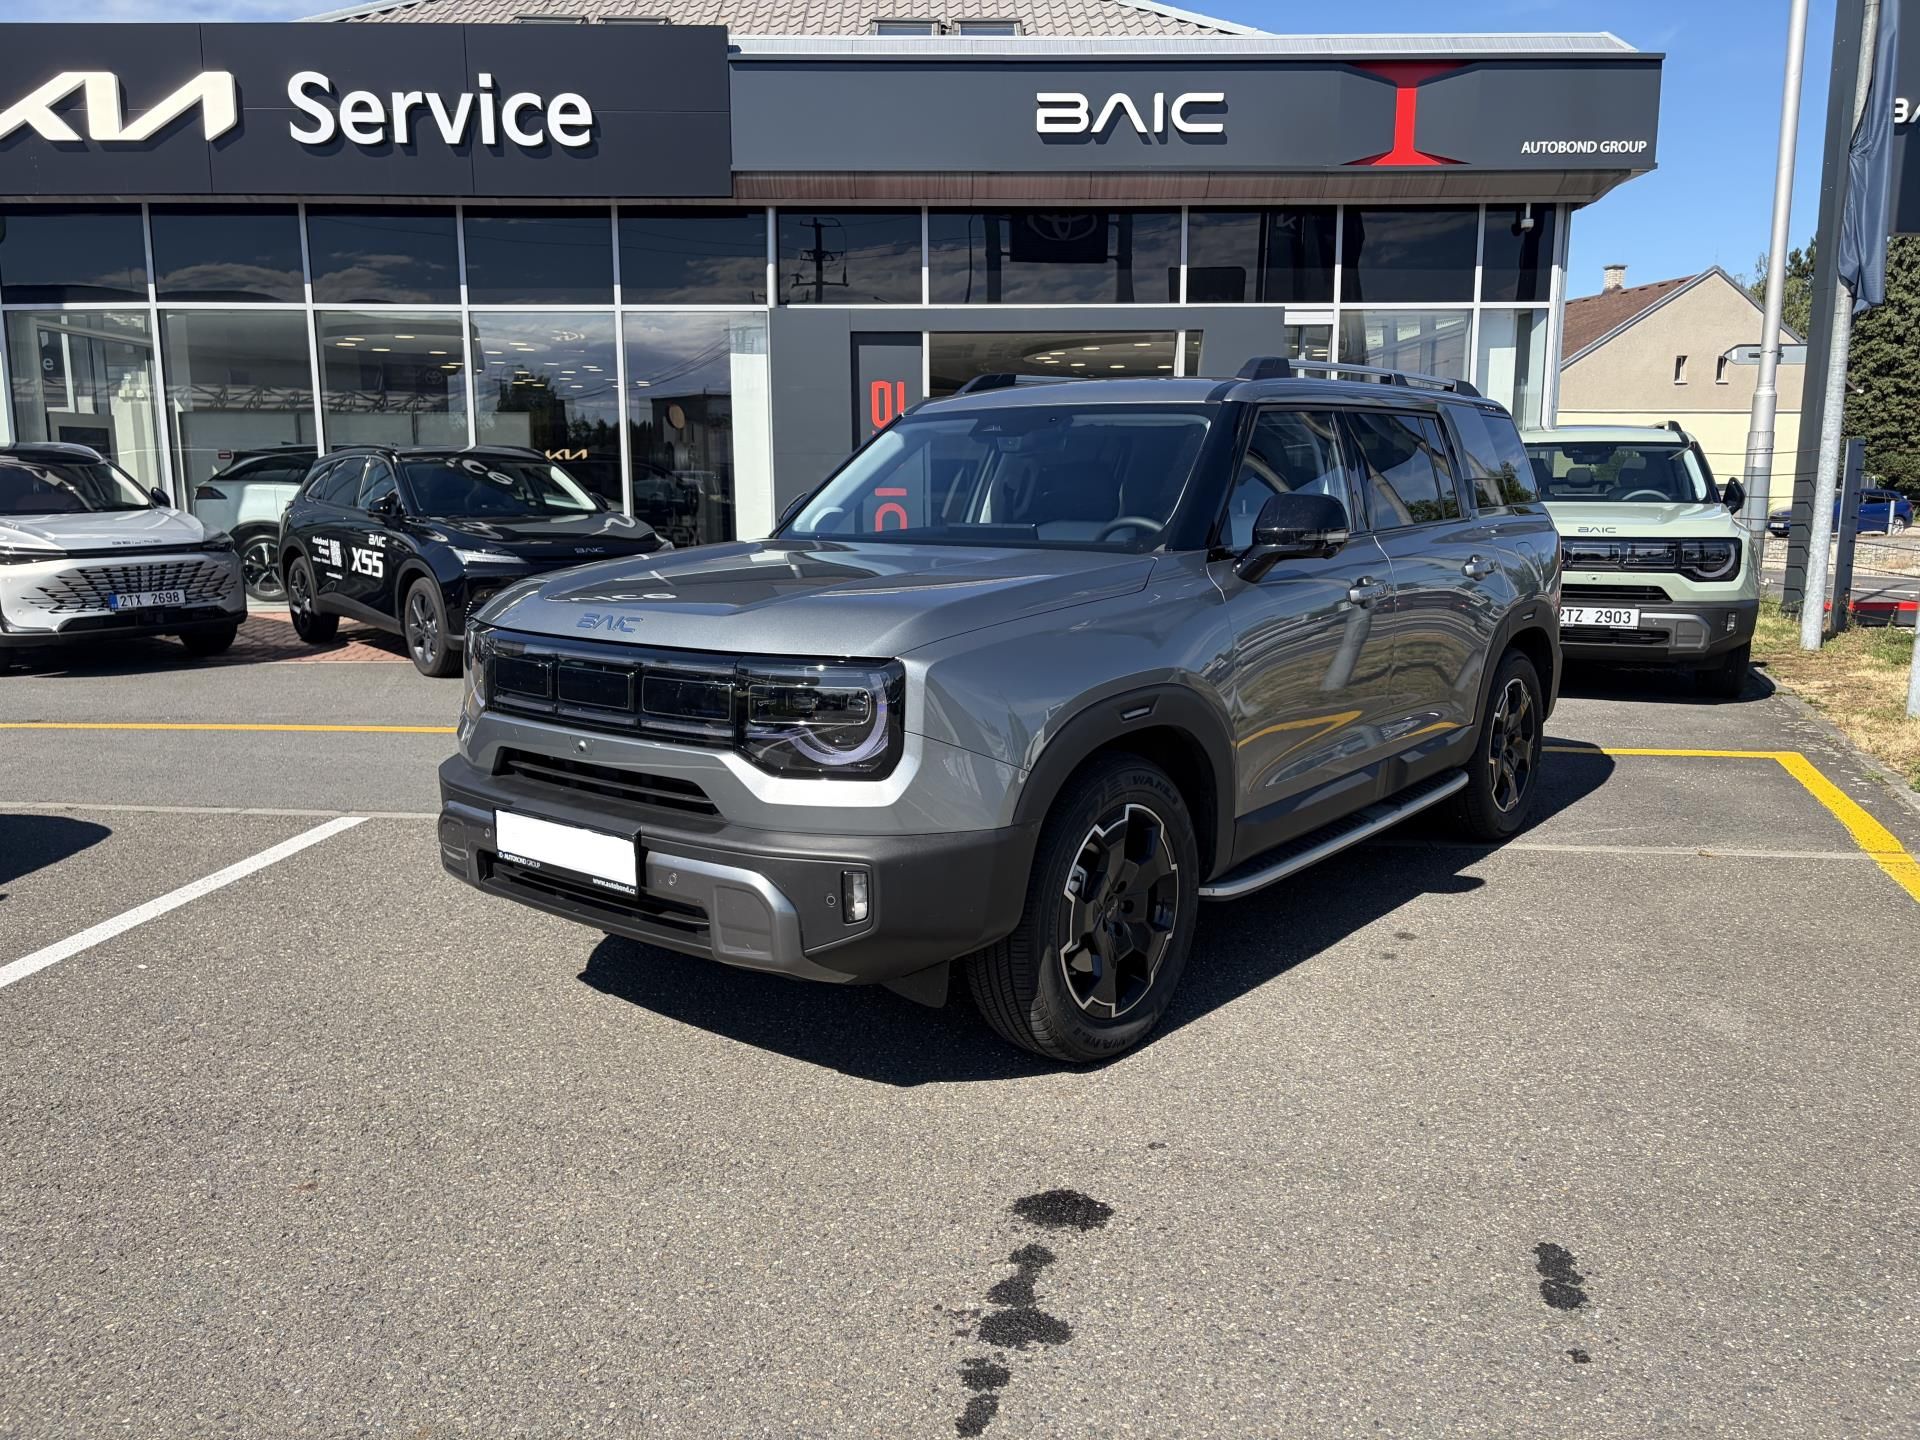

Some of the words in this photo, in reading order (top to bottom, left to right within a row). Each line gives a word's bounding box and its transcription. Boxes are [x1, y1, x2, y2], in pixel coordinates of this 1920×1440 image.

[287, 70, 593, 147] Service
[1036, 92, 1225, 133] BAIC
[1521, 140, 1598, 154] AUTOBOND
[1600, 140, 1648, 153] GROUP
[1577, 526, 1617, 534] BAIC
[351, 546, 384, 578] X55
[120, 594, 142, 608] 2TX
[151, 591, 180, 605] 2698
[576, 612, 643, 633] BAIC
[1594, 610, 1632, 624] 2903
